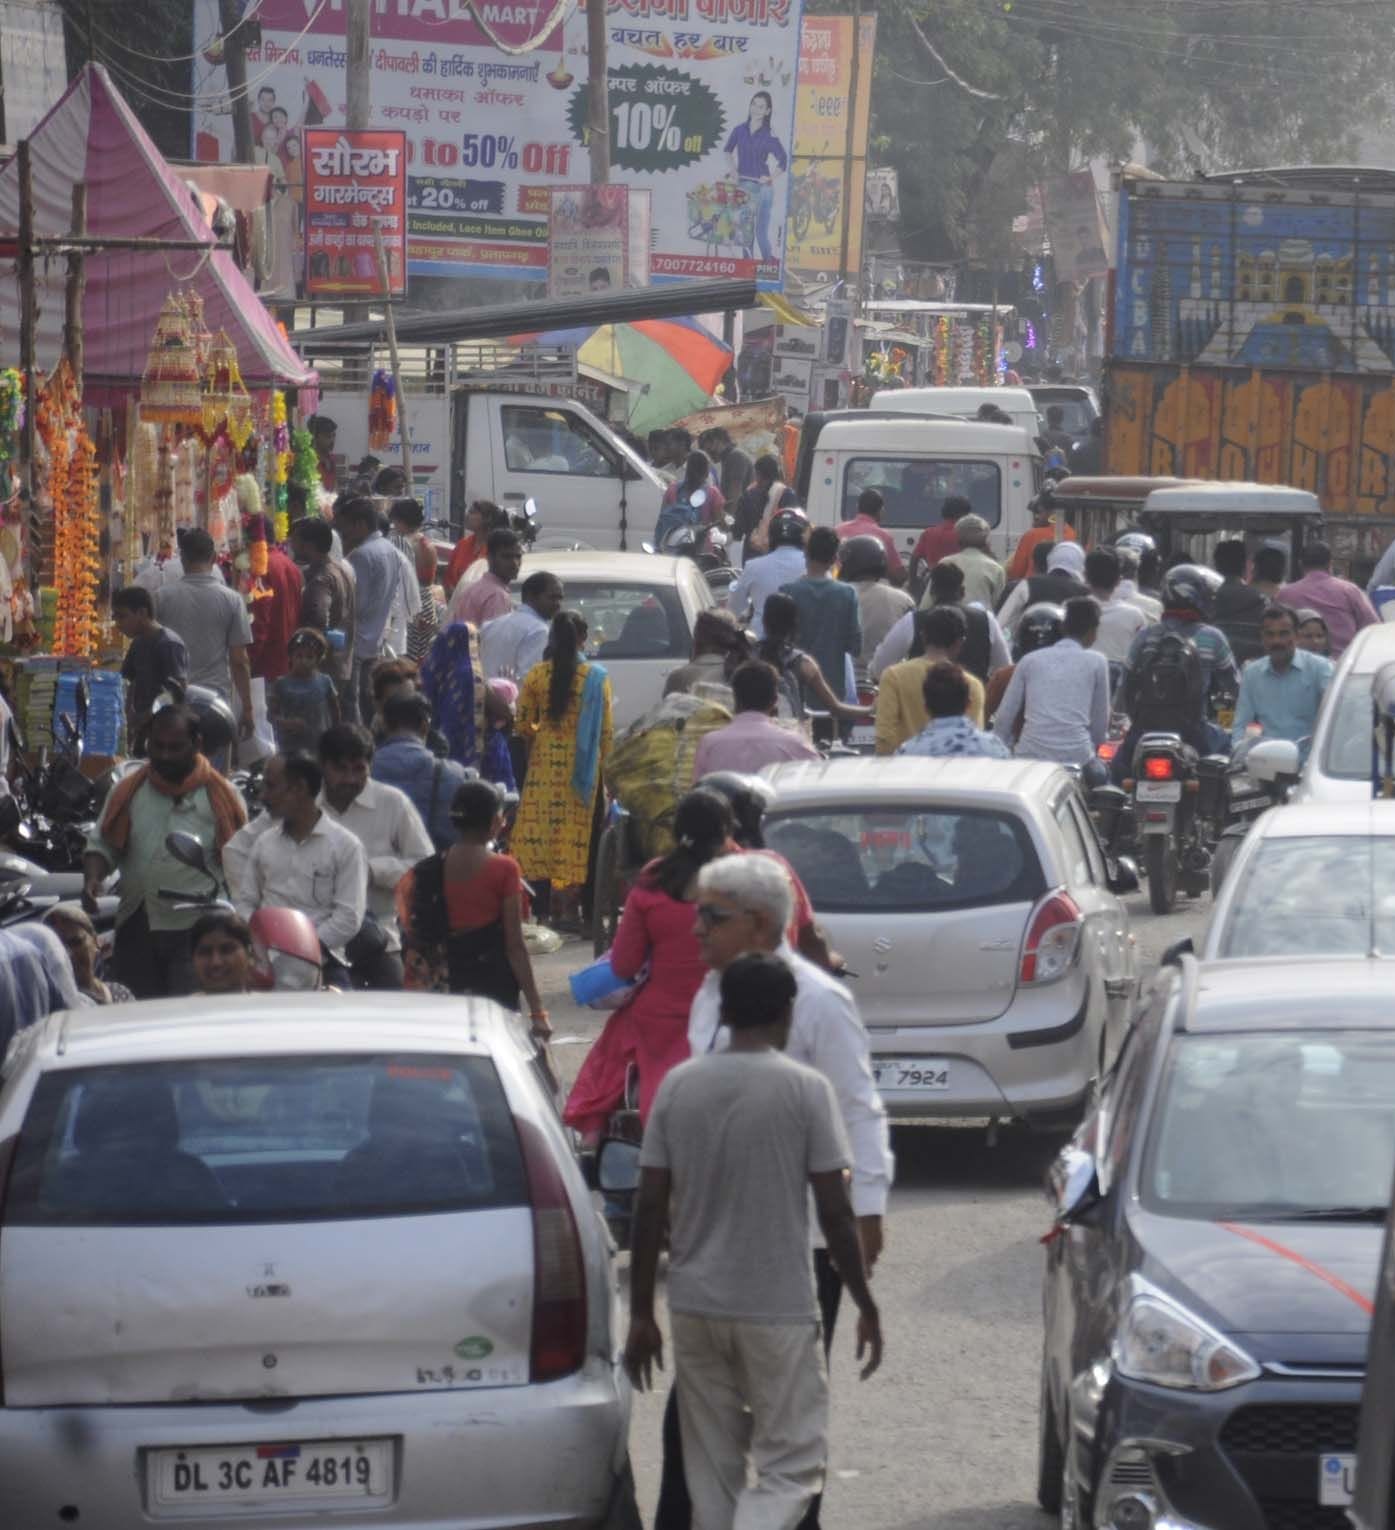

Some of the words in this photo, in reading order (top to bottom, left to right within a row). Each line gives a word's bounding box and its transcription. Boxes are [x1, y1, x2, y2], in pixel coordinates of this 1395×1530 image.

[610, 27, 662, 47] बचत
[673, 31, 701, 49] हर
[613, 102, 682, 152] 10%
[310, 135, 400, 177] सौरभ
[422, 136, 459, 167] to
[462, 133, 519, 169] 50%
[897, 1070, 949, 1085] 7924
[174, 1462, 208, 1491] DL
[217, 1460, 252, 1490] 3C
[262, 1459, 297, 1488] AF
[306, 1455, 370, 1486] 4819
